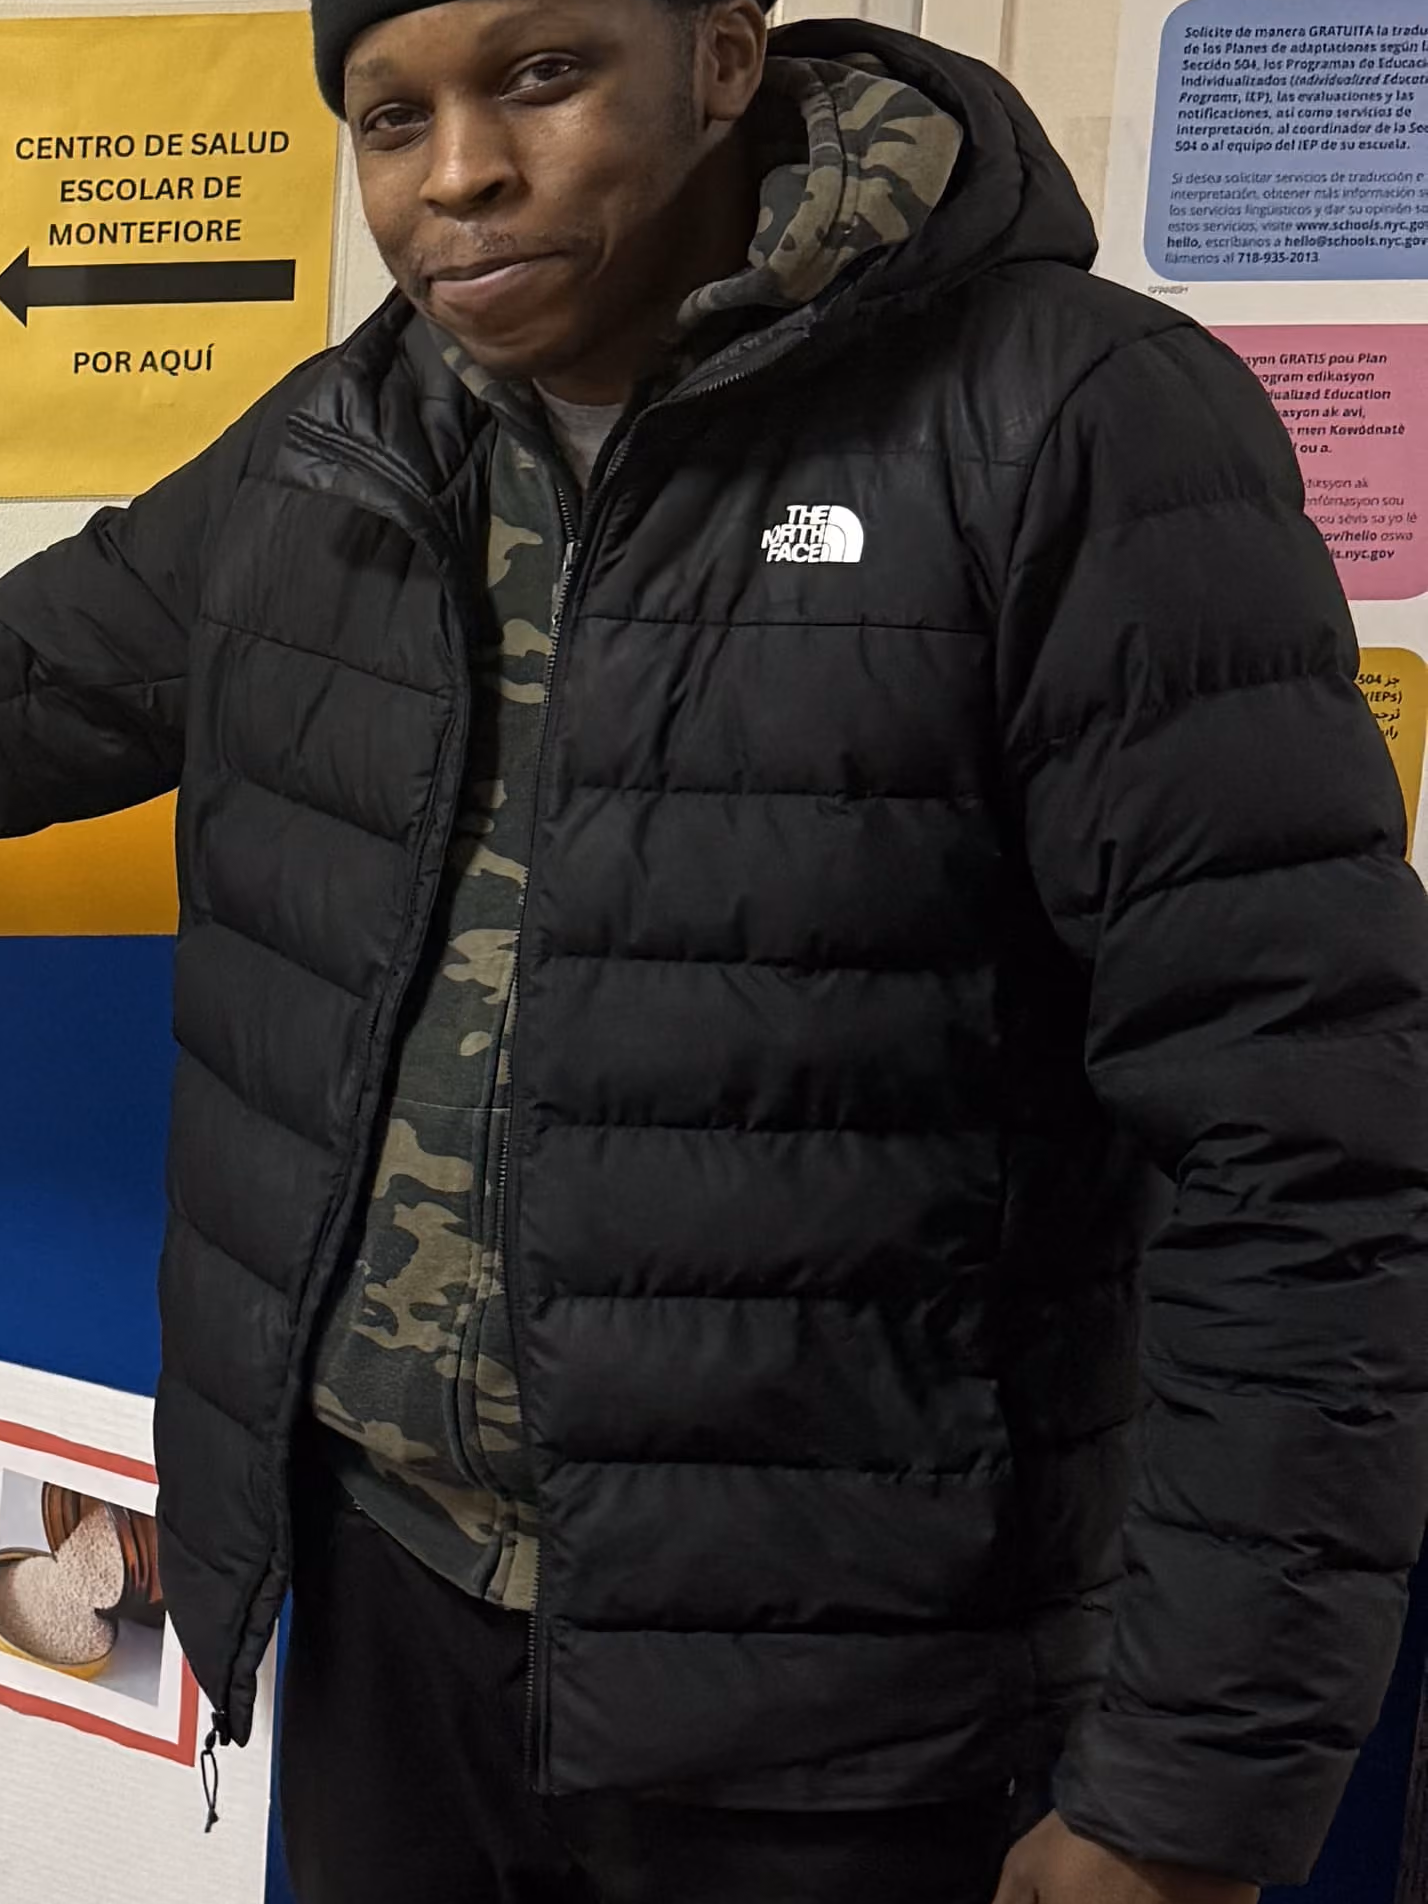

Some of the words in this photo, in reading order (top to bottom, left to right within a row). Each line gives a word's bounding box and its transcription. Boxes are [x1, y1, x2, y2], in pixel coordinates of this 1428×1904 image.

[1309, 25, 1373, 36] GRATUITA
[15, 134, 135, 160] CENTRO
[144, 133, 184, 157] DE
[190, 130, 290, 156] SALUD
[59, 177, 195, 203] ESCOLAR
[203, 175, 242, 199] DE
[48, 218, 242, 246] MONTEFIORE
[1237, 252, 1319, 263] 718-935-2013
[73, 350, 133, 375] POR
[139, 343, 216, 377] AQUÍ
[1279, 353, 1326, 365] GRATIS
[1357, 352, 1387, 364] Plan
[786, 504, 831, 525] THE
[760, 523, 826, 550] NORTH
[766, 543, 822, 563] FACE
